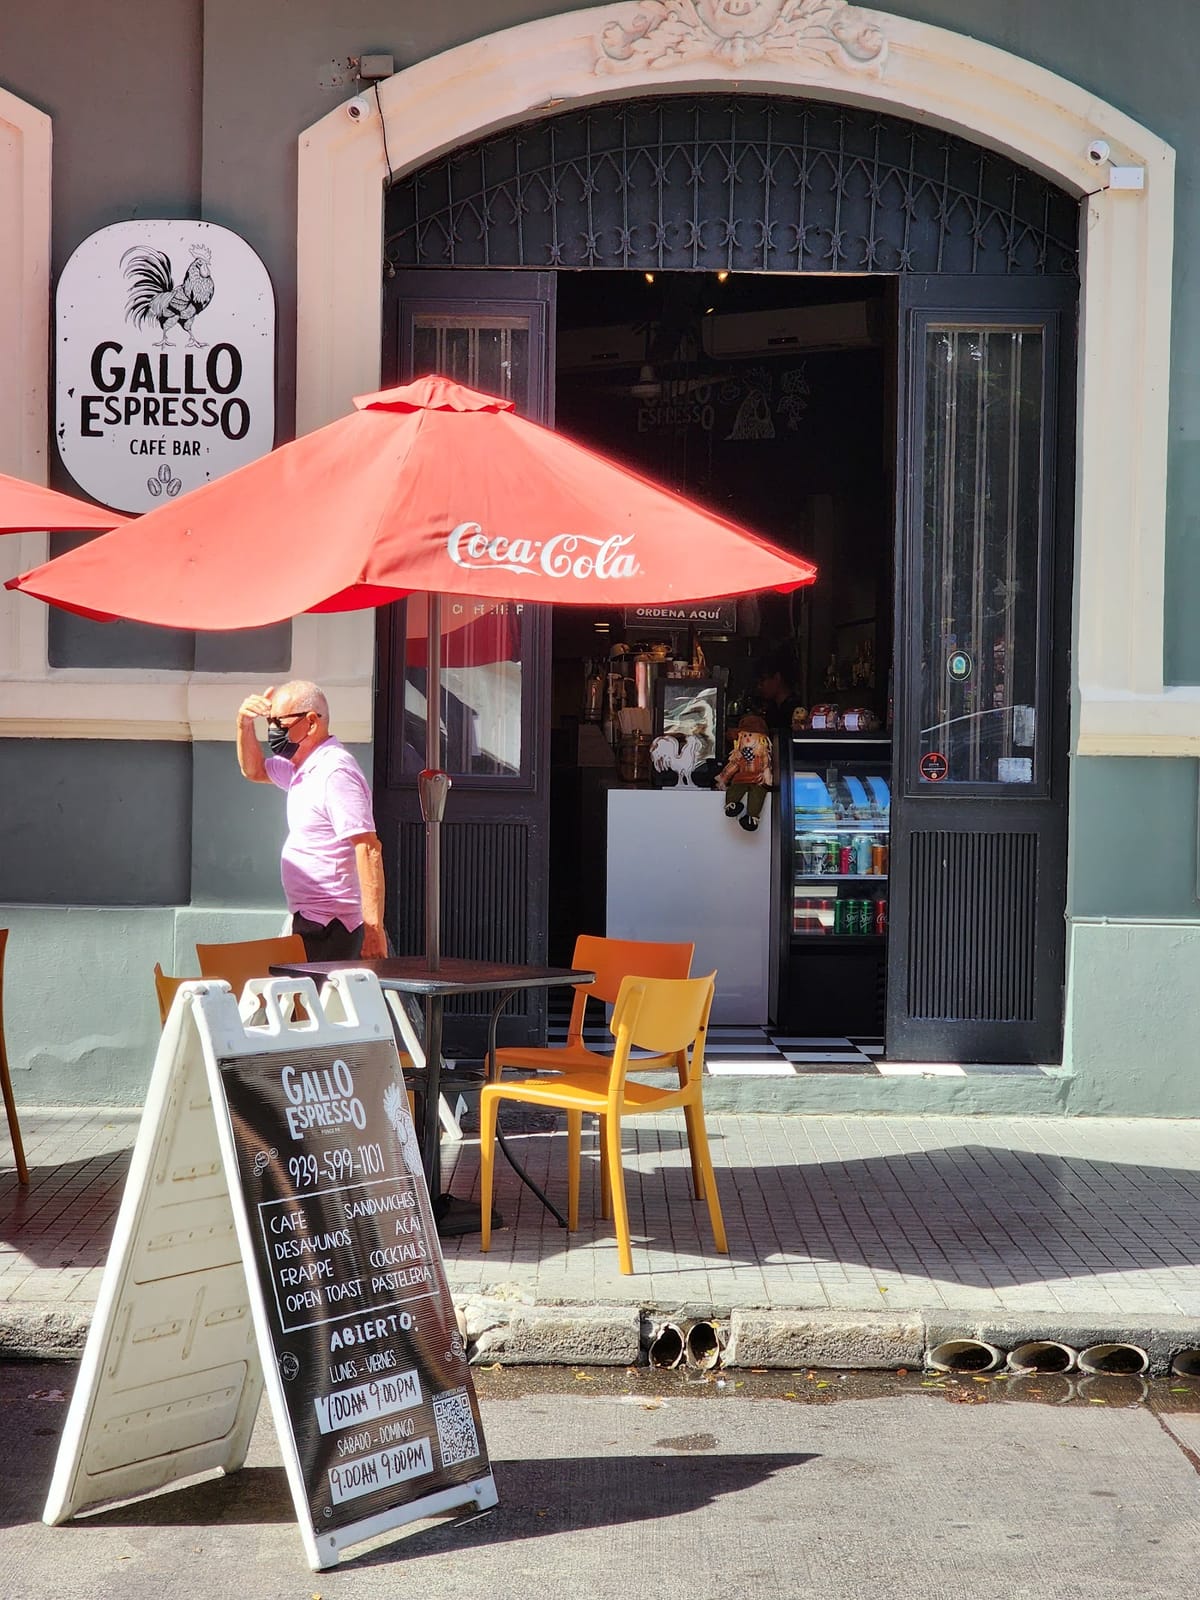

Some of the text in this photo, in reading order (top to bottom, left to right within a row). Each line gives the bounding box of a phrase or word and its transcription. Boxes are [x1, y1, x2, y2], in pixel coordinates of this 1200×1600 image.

[90, 341, 243, 395] GALLO
[80, 396, 251, 440] ESPRESSO
[130, 435, 201, 456] CAFÉ BAR
[636, 606, 720, 620] ORDENA AQUÍ
[281, 1059, 354, 1105] GALLO
[285, 1097, 367, 1141] ESPRESSO
[288, 1143, 386, 1188] 939-599-1101
[270, 1191, 416, 1234] CAFE SANDWICHES
[274, 1215, 421, 1260] DESAYUNOS ACAI
[280, 1240, 427, 1288] FRAPPE COCKTAILS
[286, 1265, 432, 1313] OPEN TOAST PASTELERIA
[330, 1311, 418, 1352] ABIERTO:
[329, 1360, 358, 1384] LUNES
[365, 1349, 397, 1374] VIERNES
[379, 1418, 415, 1444] DOMINGO
